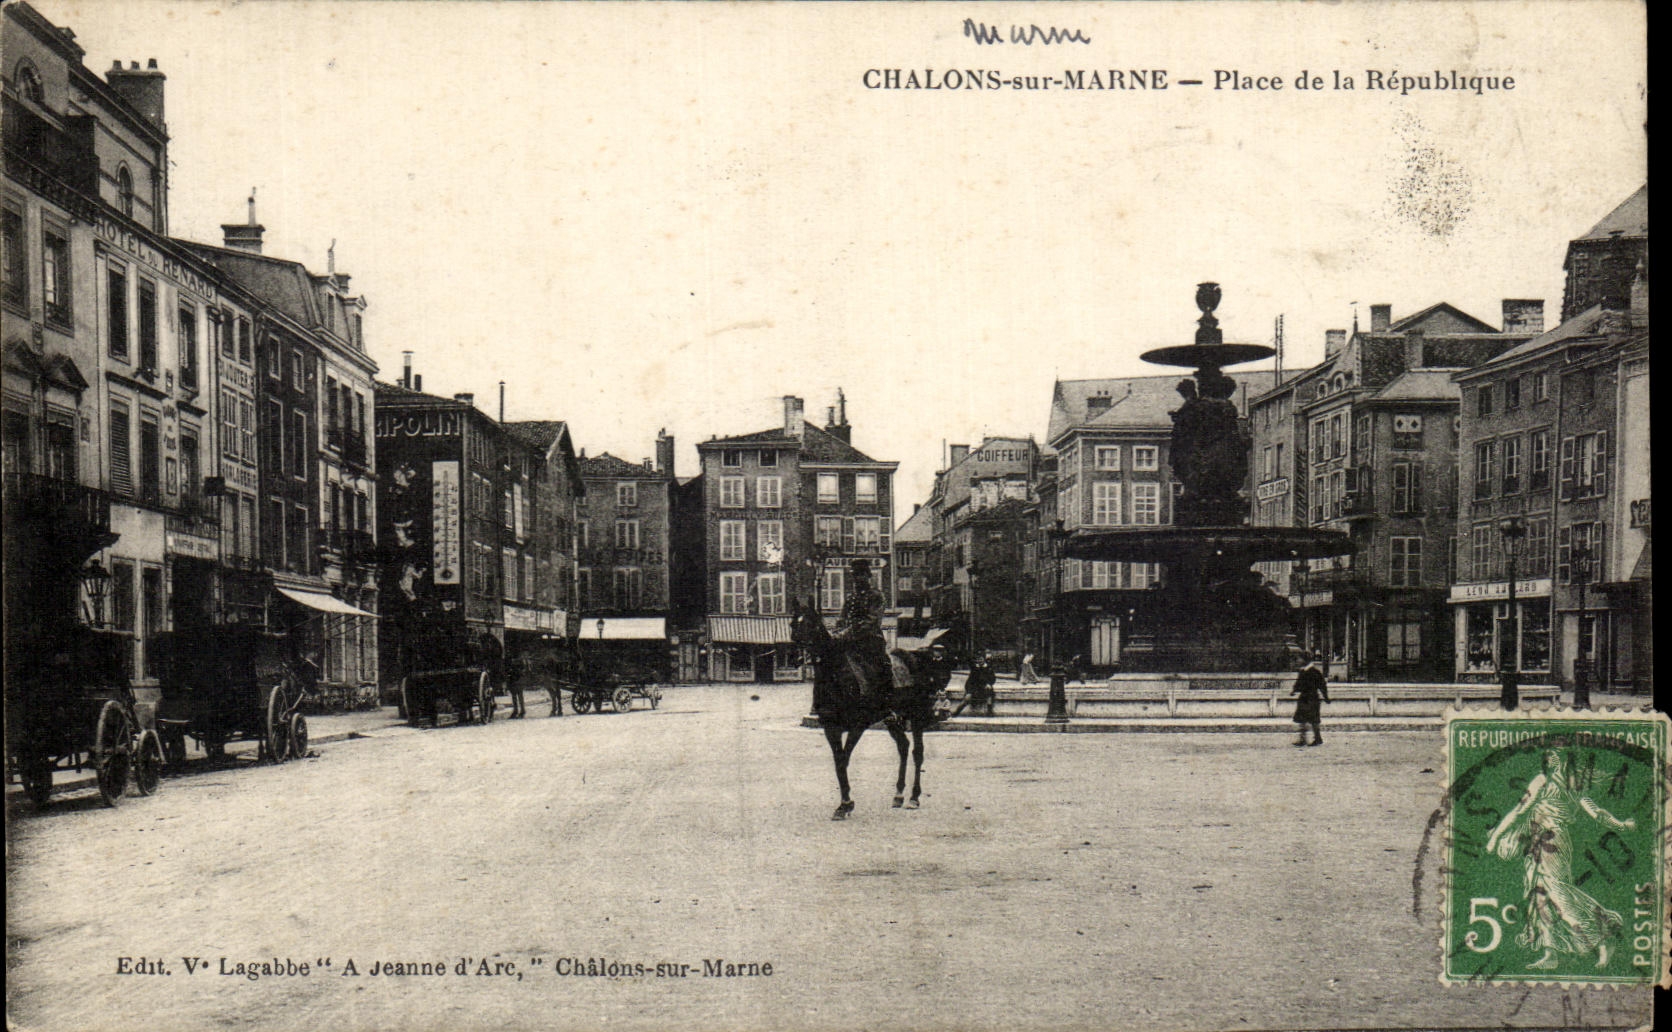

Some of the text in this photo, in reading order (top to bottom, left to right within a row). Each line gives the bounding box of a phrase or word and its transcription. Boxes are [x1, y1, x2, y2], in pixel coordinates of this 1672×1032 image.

[96, 219, 146, 260] HOTEL
[163, 256, 214, 298] RENARD
[977, 448, 1028, 462] COIFFEUR
[1633, 882, 1653, 967] POSTES
